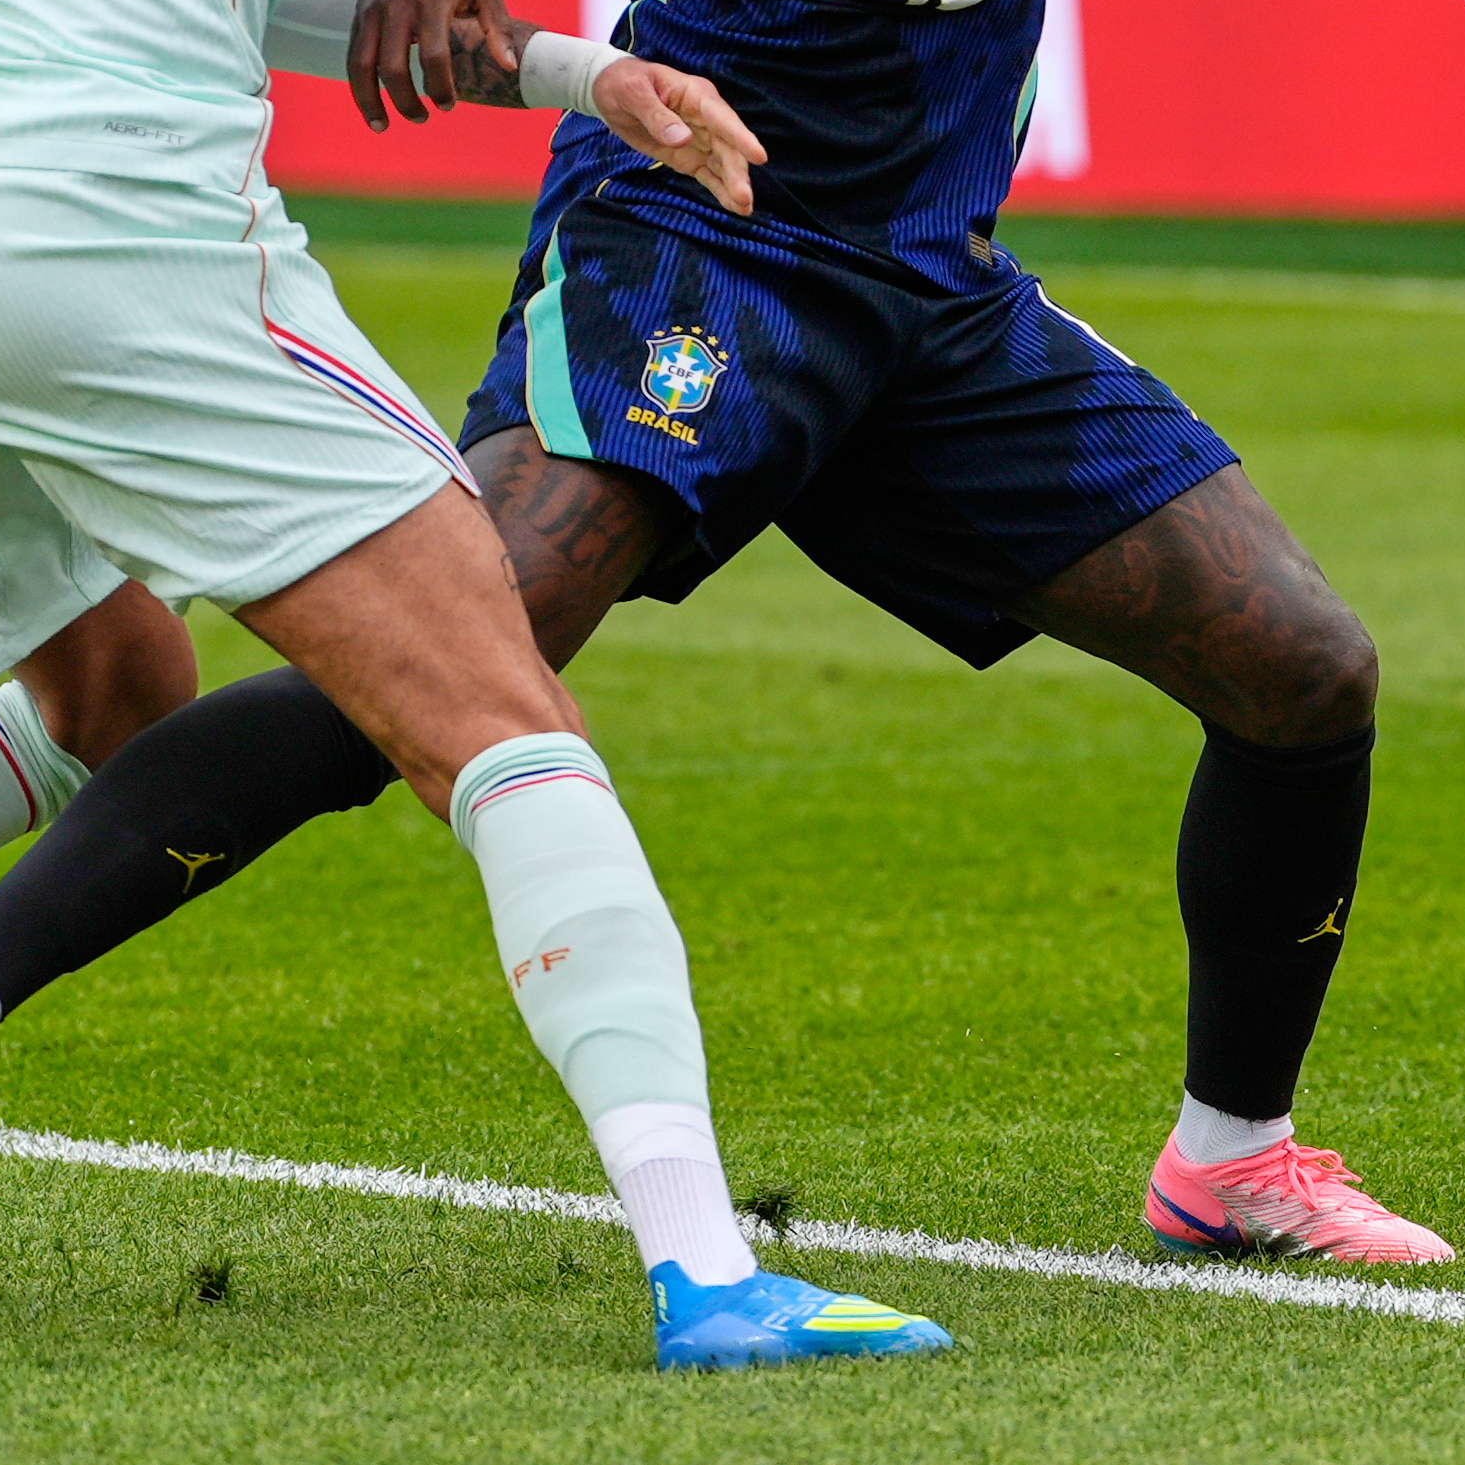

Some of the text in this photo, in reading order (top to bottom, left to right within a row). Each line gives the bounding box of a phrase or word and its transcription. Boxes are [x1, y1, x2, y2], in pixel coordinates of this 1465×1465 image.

[103, 121, 185, 145] AERO-FIT
[668, 365, 694, 379] CBF
[626, 405, 698, 446] BRASIL
